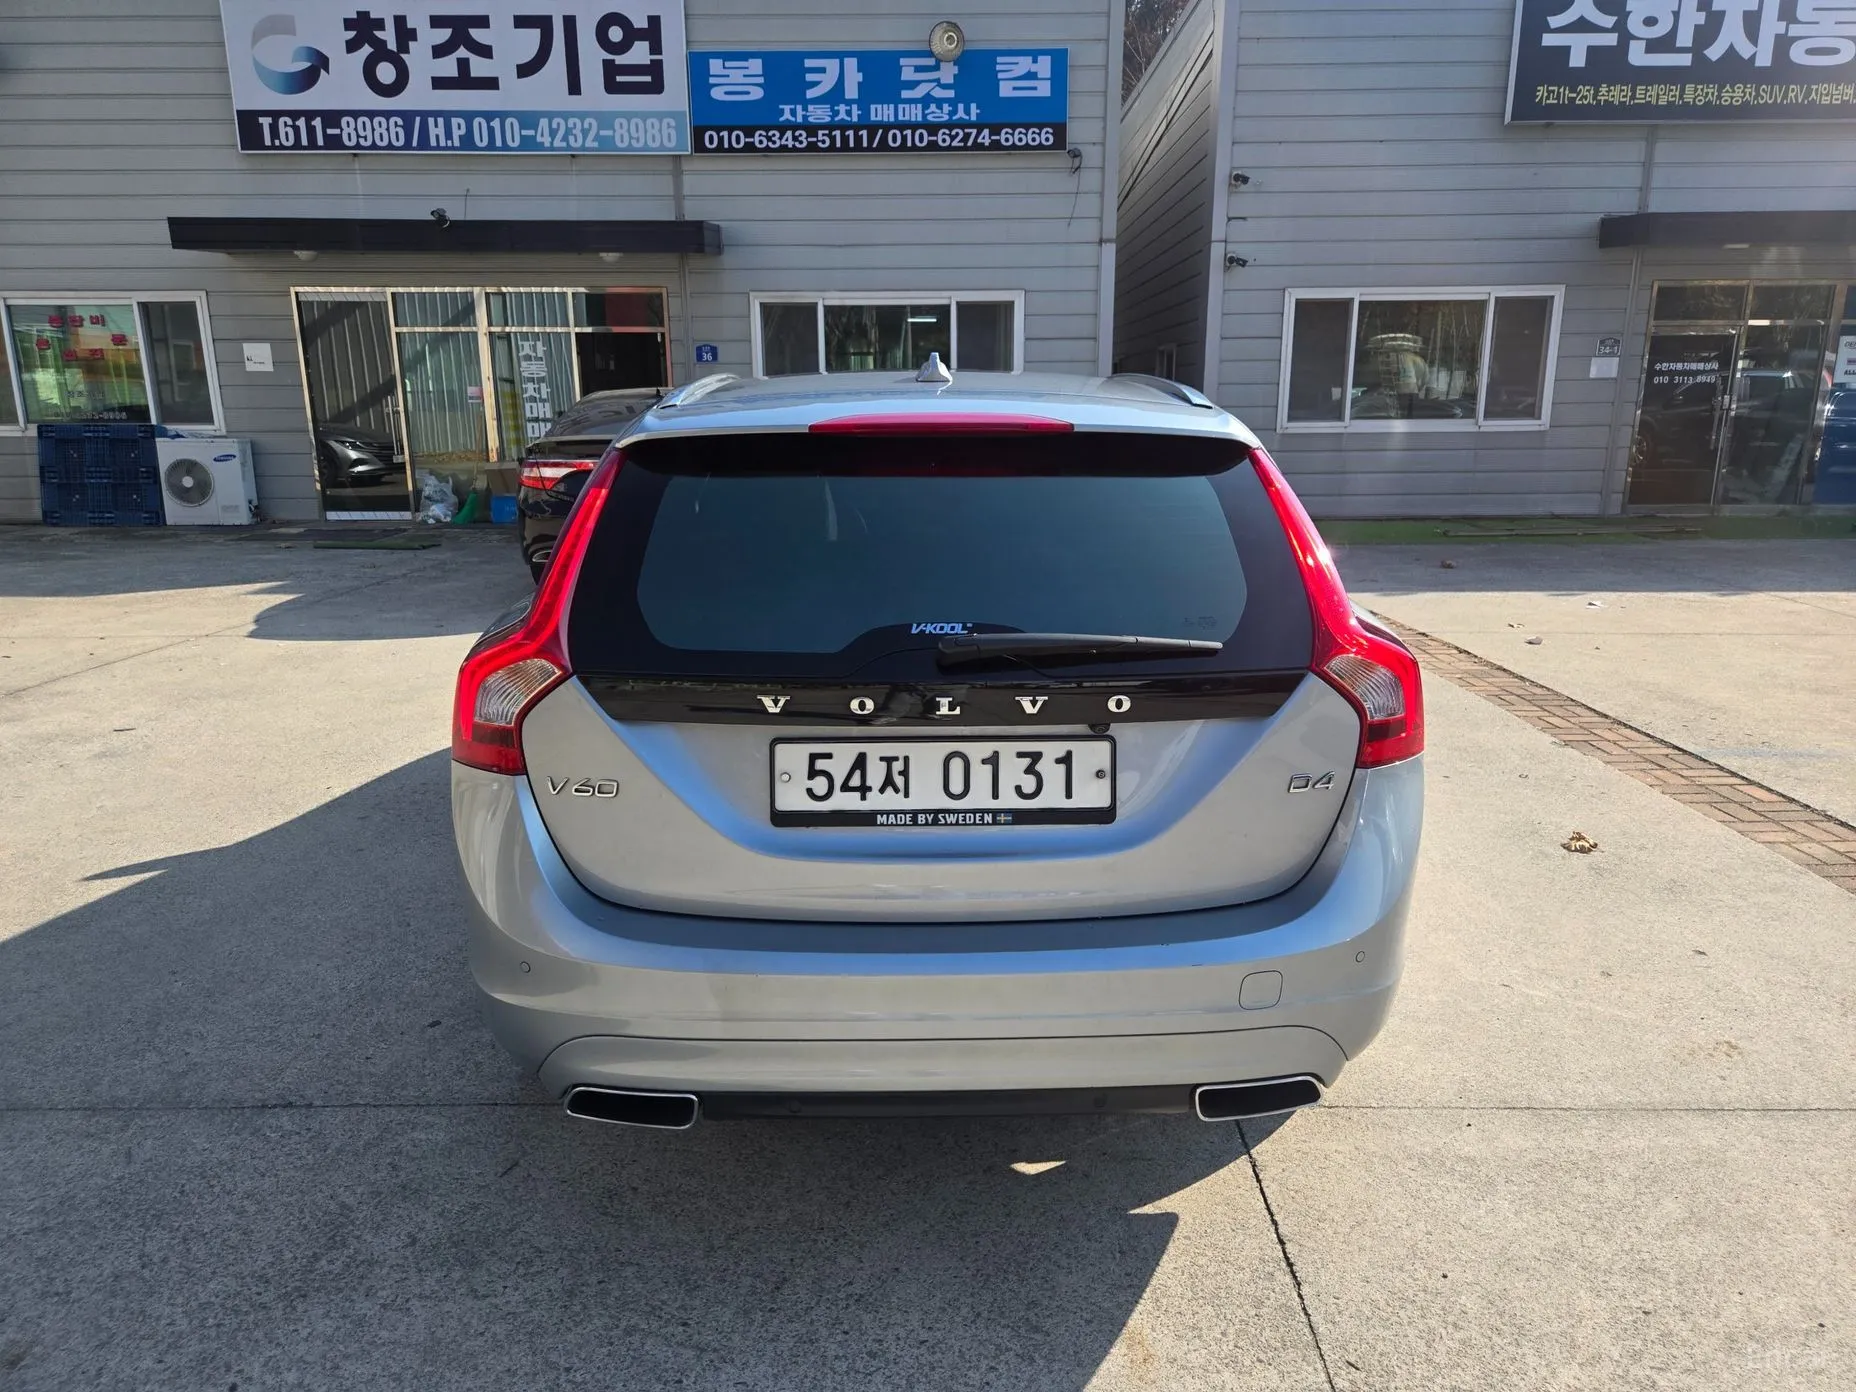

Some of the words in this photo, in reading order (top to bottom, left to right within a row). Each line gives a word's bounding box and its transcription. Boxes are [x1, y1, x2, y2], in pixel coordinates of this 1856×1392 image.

[343, 10, 665, 98] 창조기업
[778, 103, 862, 123] 자동차
[870, 101, 980, 122] 매매상사
[473, 117, 677, 148] 010-4232-8986
[702, 352, 713, 361] 36
[1653, 376, 1669, 384] 010
[911, 623, 969, 634] V-KOOL
[757, 694, 1132, 716] VOLVO
[805, 751, 910, 801] 54저
[942, 750, 1074, 801] 0131
[1288, 770, 1335, 793] D4
[547, 776, 619, 798] V60
[876, 813, 913, 825] MADE
[917, 813, 934, 825] BY
[938, 812, 993, 824] SWEDEN
